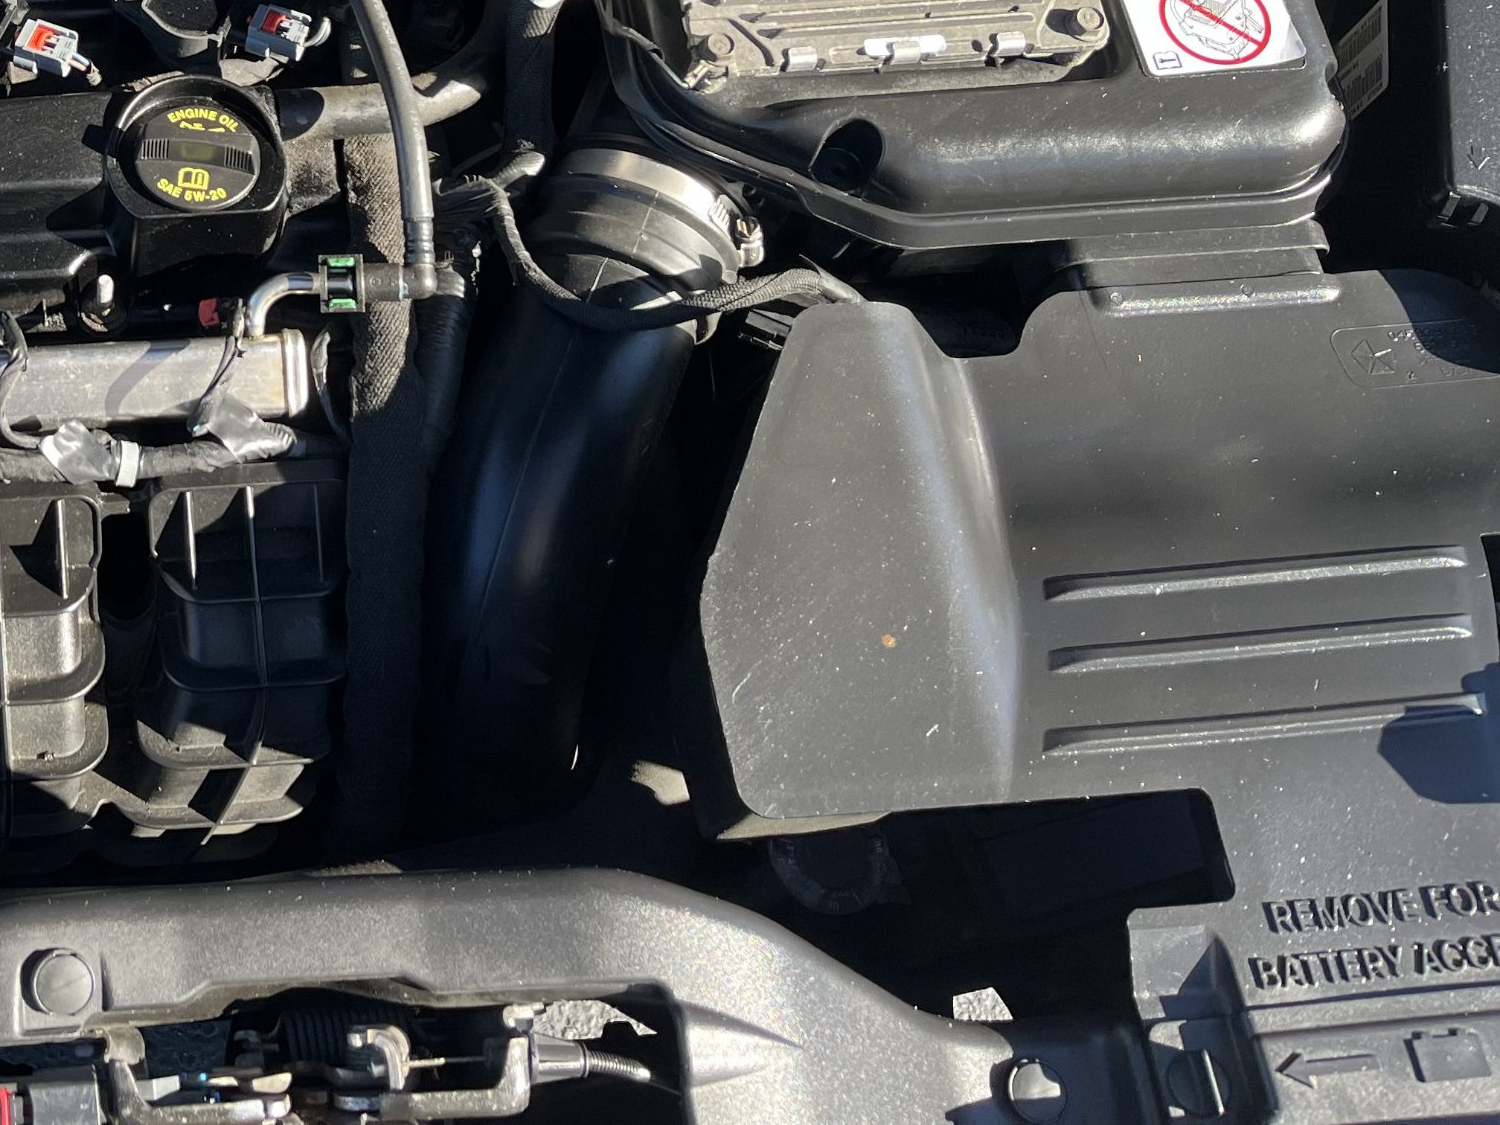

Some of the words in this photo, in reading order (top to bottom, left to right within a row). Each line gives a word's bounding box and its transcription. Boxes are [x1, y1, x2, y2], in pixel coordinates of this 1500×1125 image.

[167, 108, 218, 123] ENGINE
[219, 114, 239, 132] OIL
[156, 178, 183, 198] SAE
[184, 187, 227, 202] 5W-20
[1261, 888, 1421, 934] REMOVE
[1418, 880, 1500, 920] FOR
[1248, 944, 1403, 990] BATTERY
